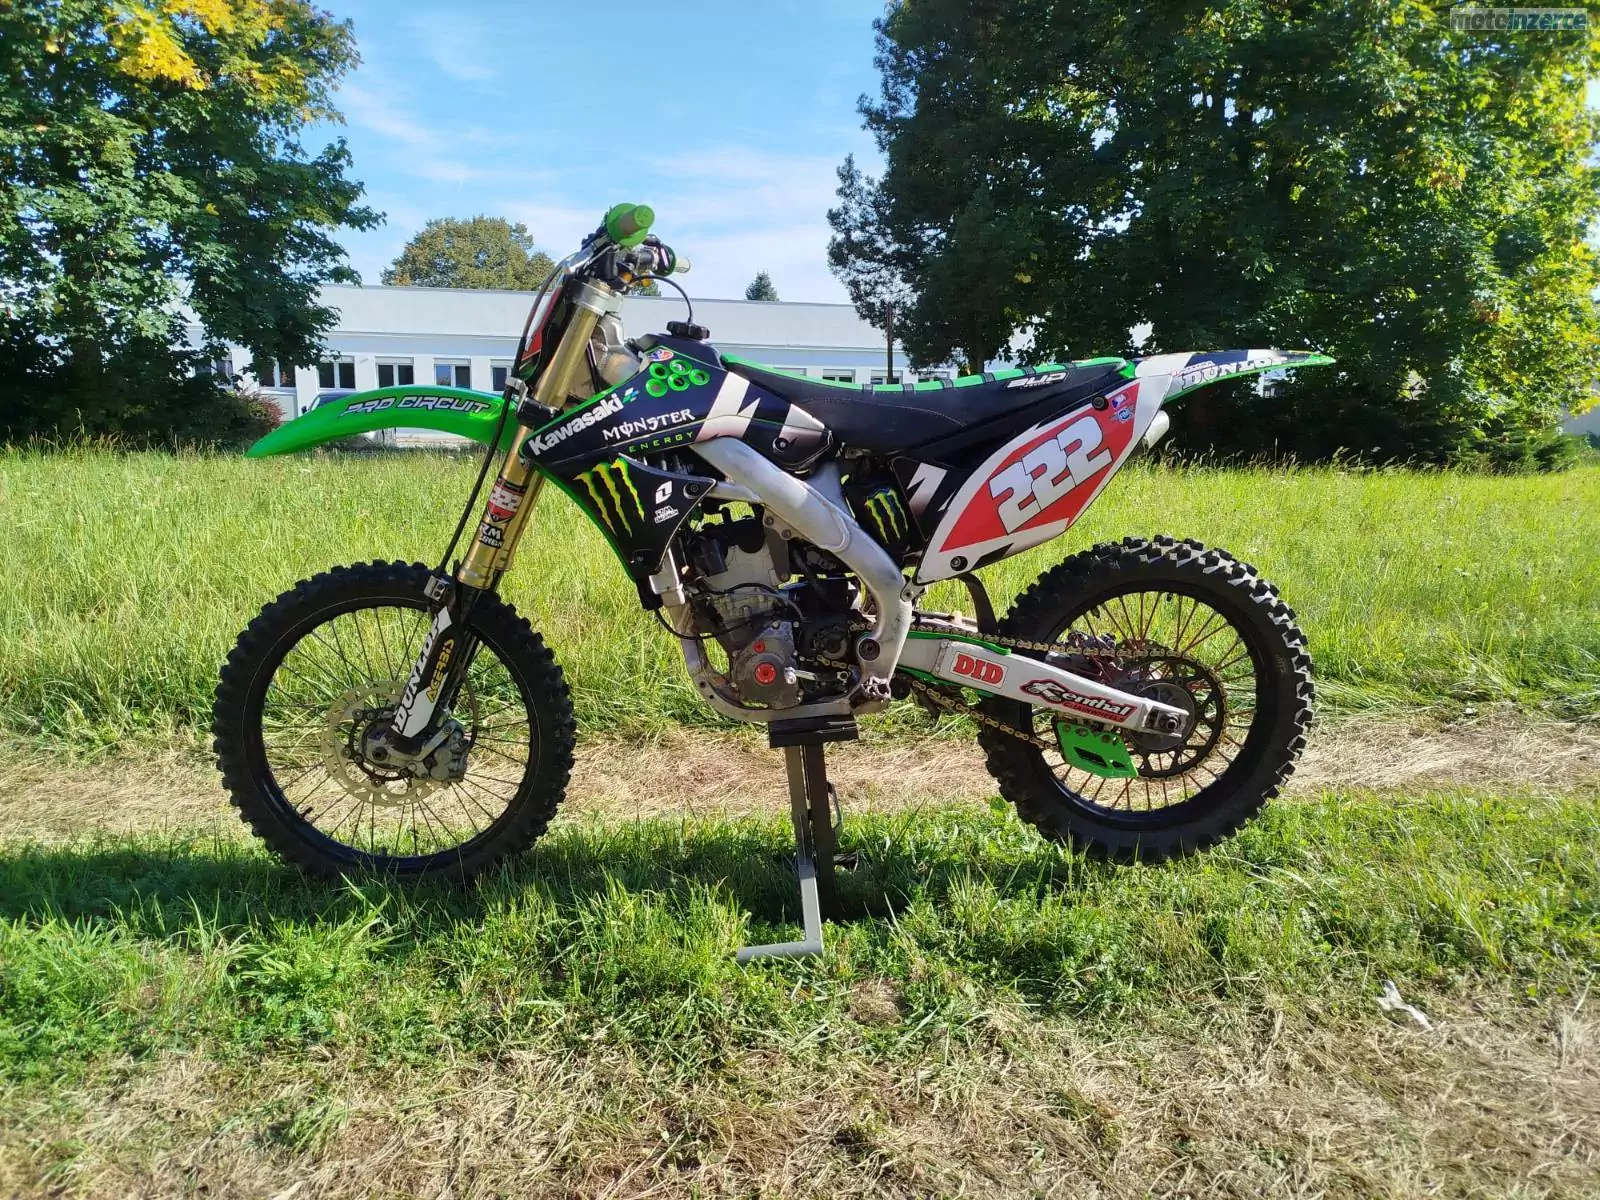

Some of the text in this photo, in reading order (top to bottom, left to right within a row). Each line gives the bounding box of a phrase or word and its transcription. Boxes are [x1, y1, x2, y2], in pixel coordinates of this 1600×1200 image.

[339, 395, 491, 417] PRO CIRCUIT
[528, 393, 625, 456] Kawasaki
[602, 408, 696, 440] MONSTER
[628, 431, 694, 453] ENERGY
[988, 415, 1112, 535] 222
[953, 654, 1004, 685] DID
[1025, 680, 1131, 716] Renthal
